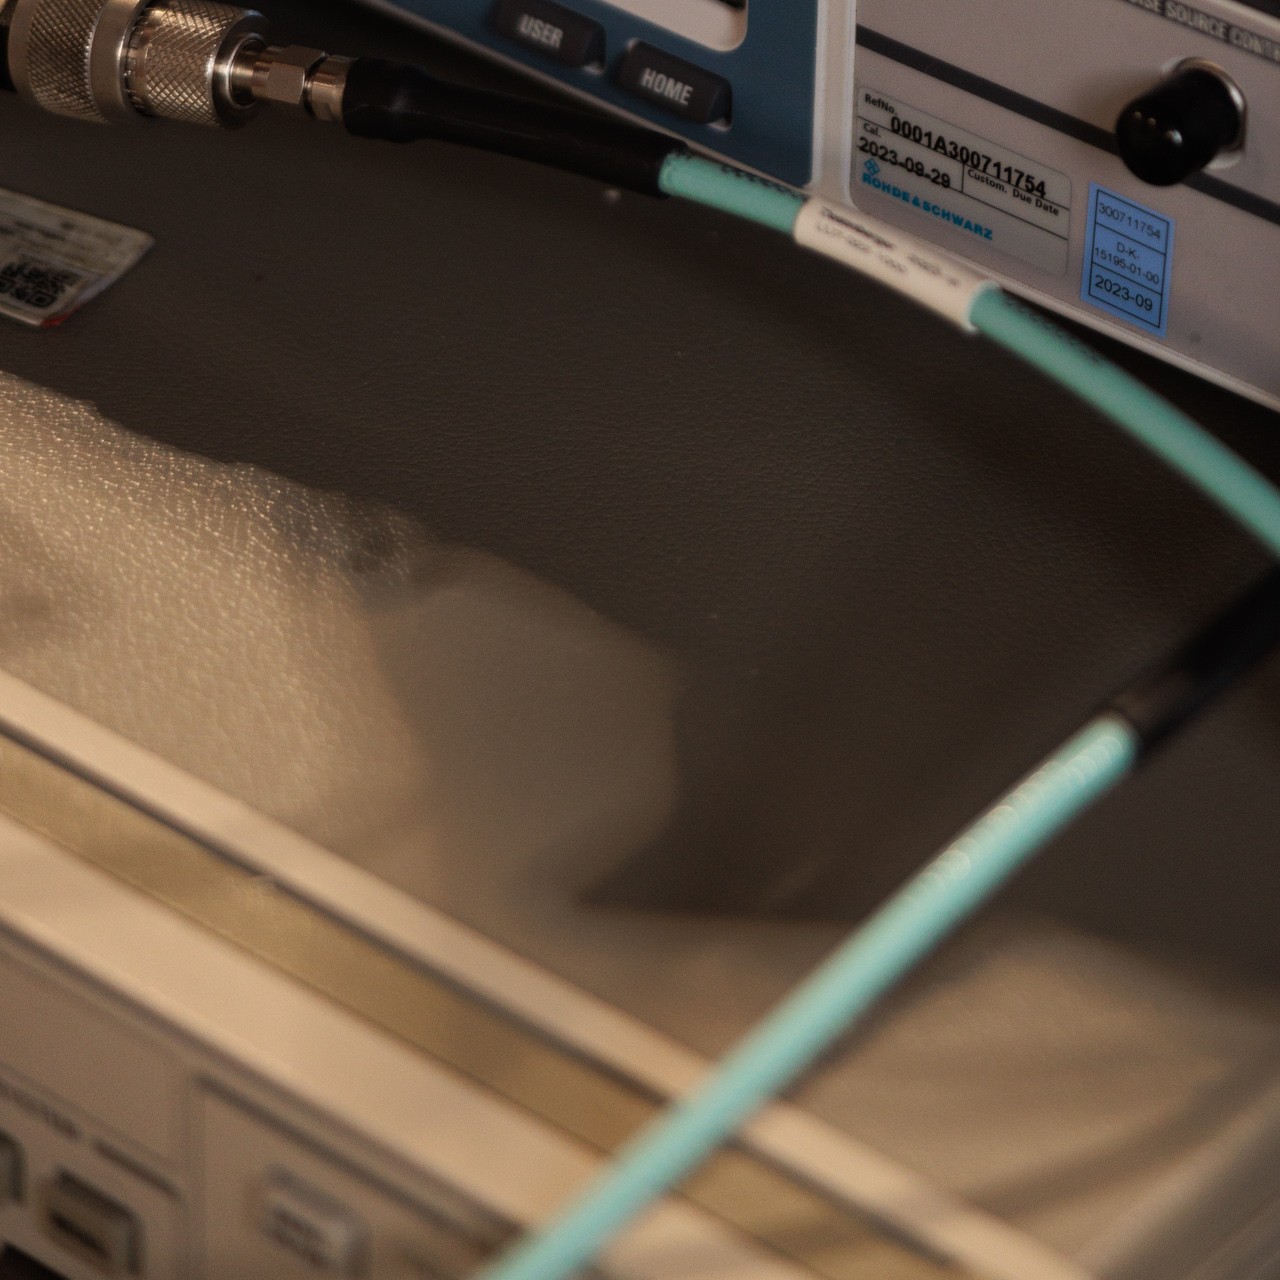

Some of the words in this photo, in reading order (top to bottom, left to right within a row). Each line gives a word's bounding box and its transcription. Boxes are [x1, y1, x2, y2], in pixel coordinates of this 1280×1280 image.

[518, 13, 565, 51] USER
[640, 67, 694, 107] HOME
[865, 92, 898, 116] RefNo.
[863, 122, 882, 138] Cal.
[858, 136, 952, 189] 2023-09-29
[890, 115, 1047, 199] 0001A300711754
[861, 172, 994, 241] ROHDE&SCHWARZ
[967, 168, 1008, 194] Custom.
[1012, 188, 1032, 204] Due
[1035, 197, 1060, 217] Date
[1098, 202, 1161, 240] 300711754
[1094, 246, 1160, 285] 15195-01-00
[1095, 274, 1153, 312] 2023-09
